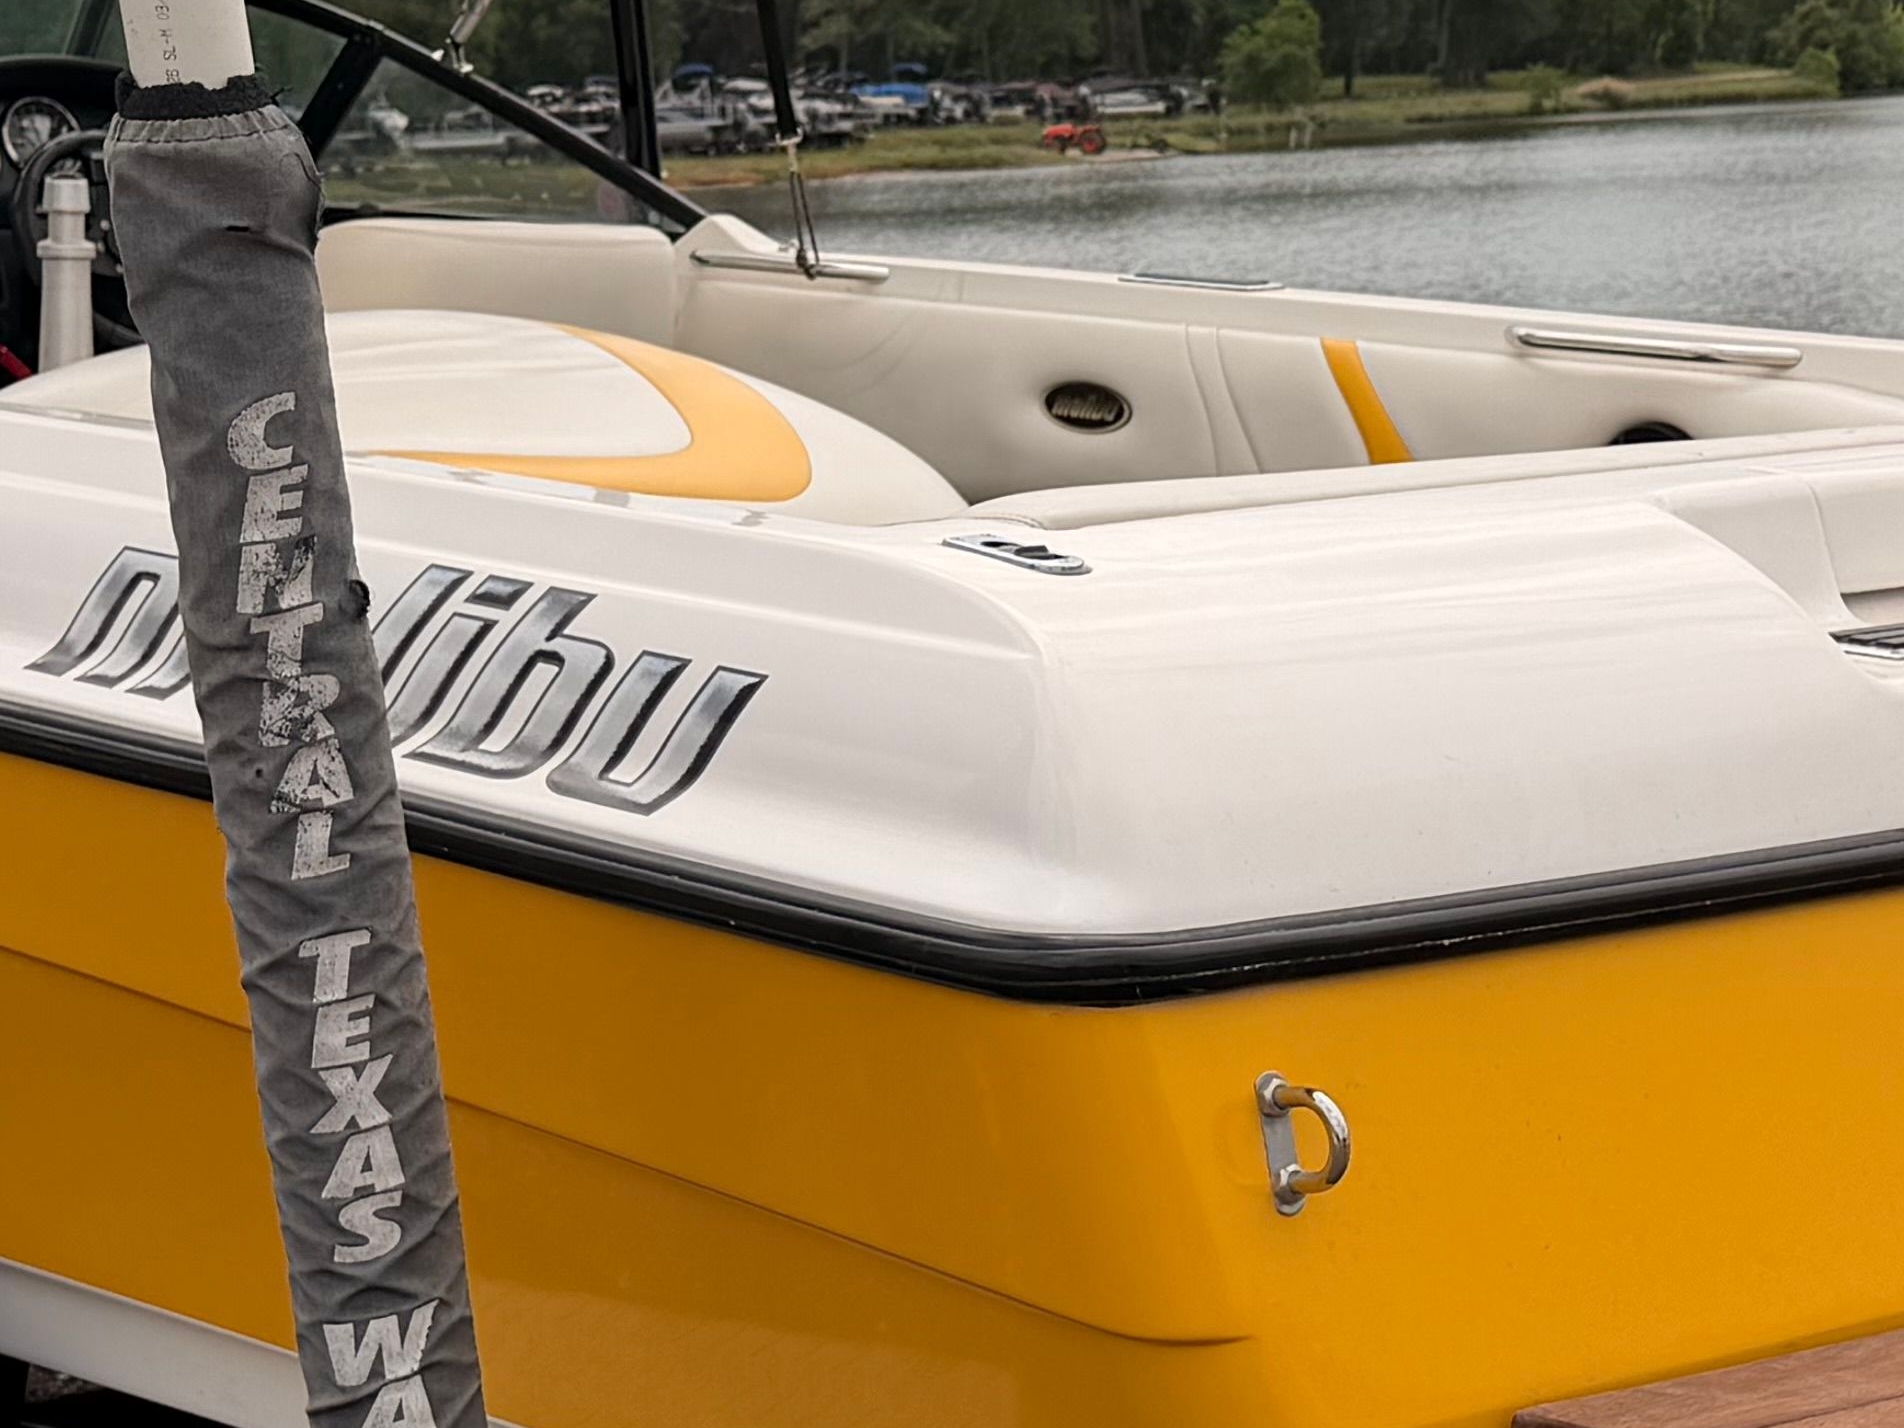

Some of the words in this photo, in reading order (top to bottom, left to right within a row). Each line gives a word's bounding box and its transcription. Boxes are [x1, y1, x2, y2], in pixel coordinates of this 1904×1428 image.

[23, 546, 768, 816] mlibu
[227, 391, 354, 881] CENTRAL
[298, 927, 406, 1264] TEXAS
